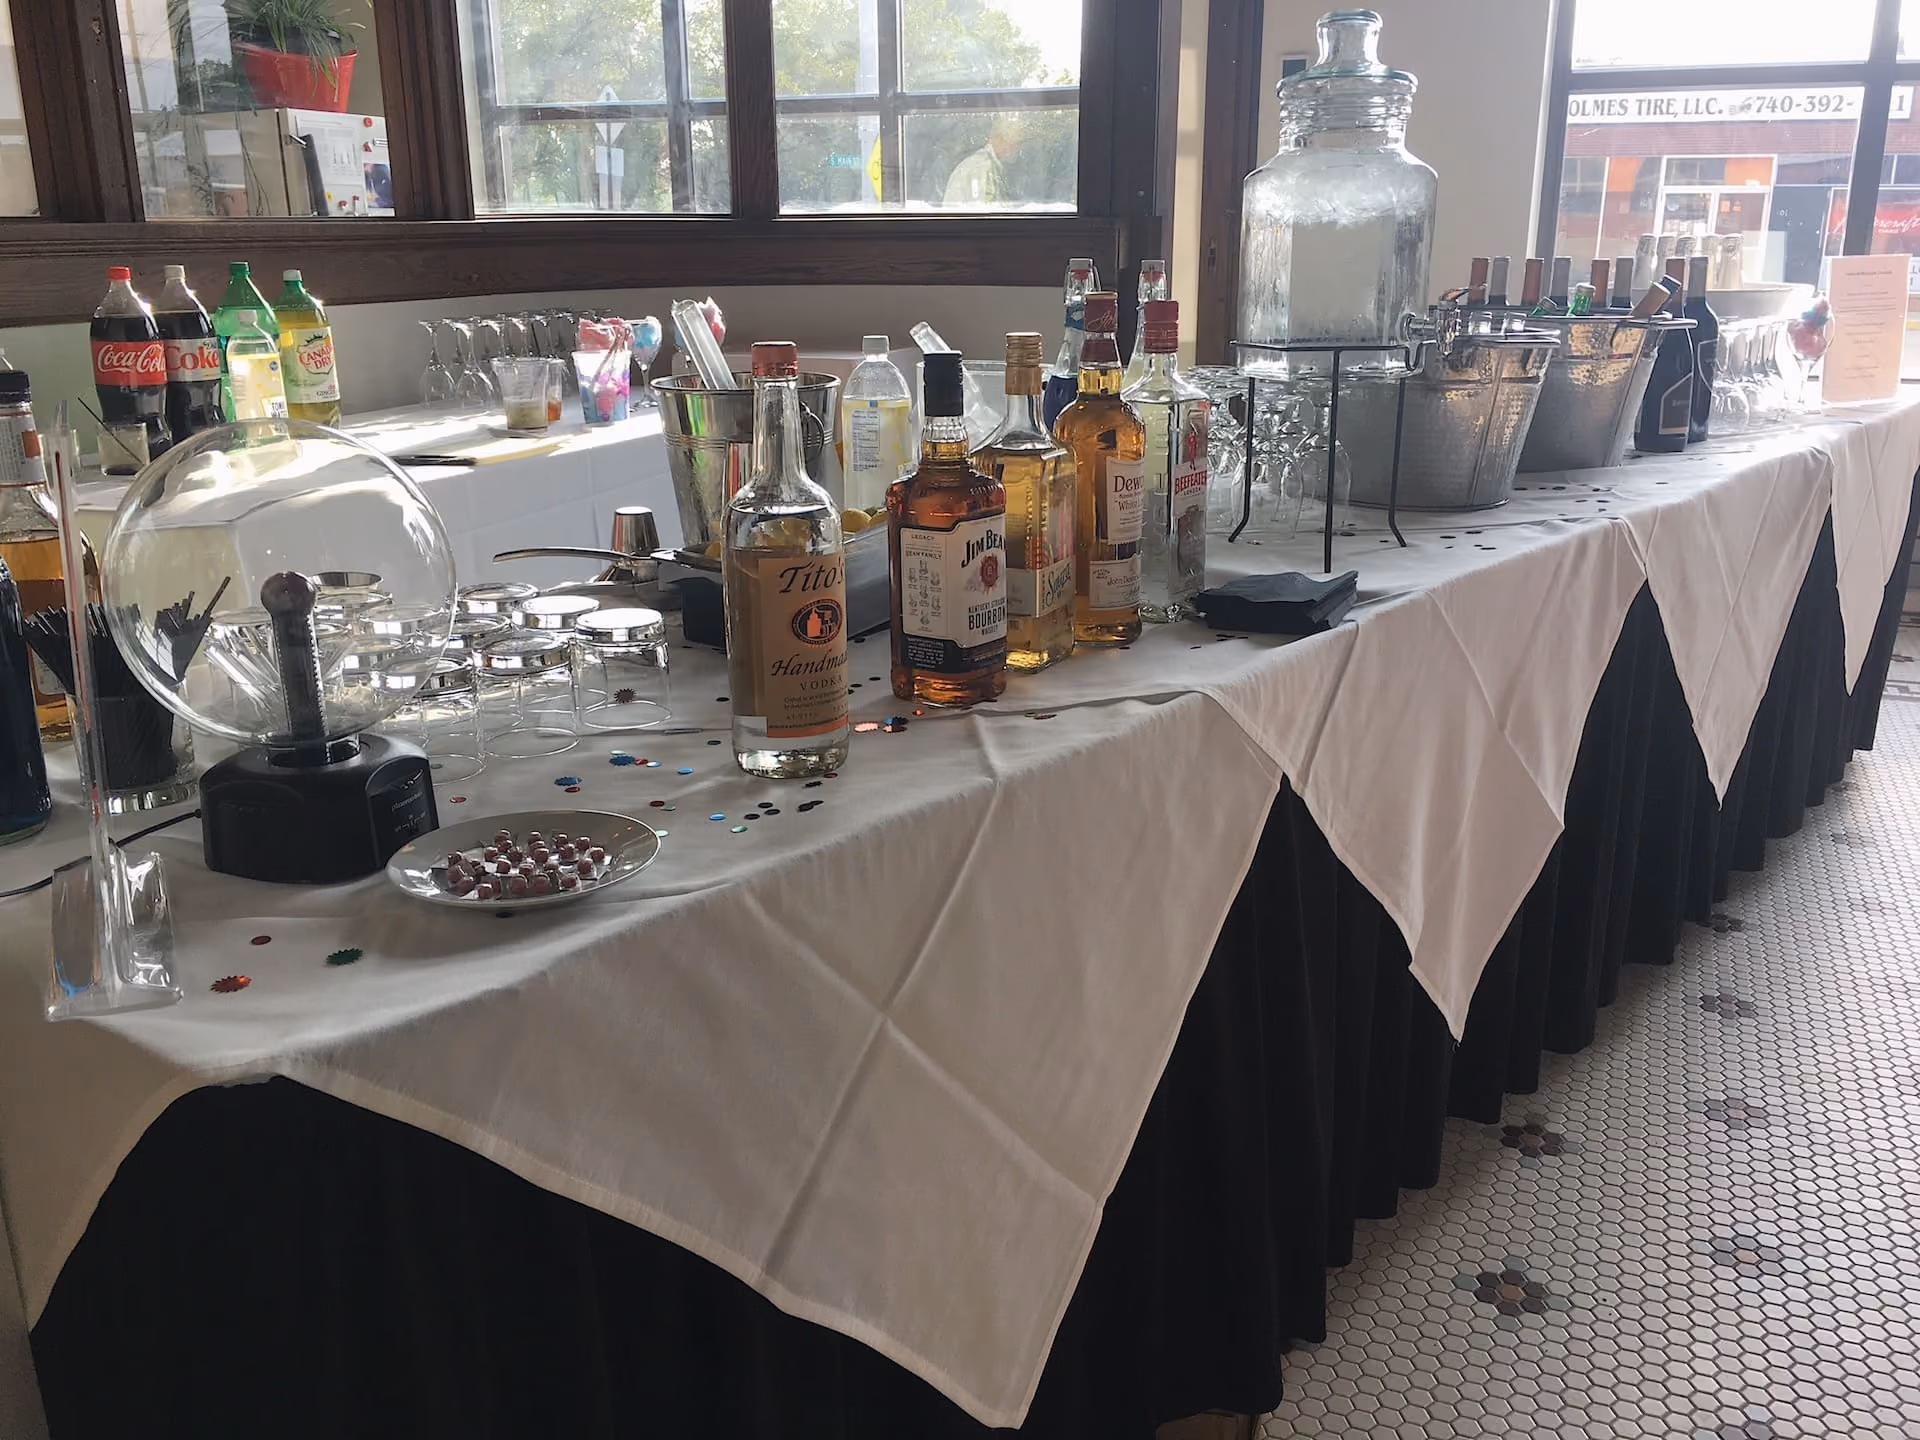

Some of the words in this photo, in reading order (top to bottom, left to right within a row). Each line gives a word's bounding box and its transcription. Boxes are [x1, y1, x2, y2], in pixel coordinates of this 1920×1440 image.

[1568, 98, 1629, 117] OLMES
[1636, 98, 1678, 118] TIRE,
[1683, 97, 1723, 115] LLC.
[97, 343, 166, 373] Coca-Cola
[299, 344, 334, 367] CANAD
[314, 356, 333, 370] DRY
[911, 533, 936, 541] LEGACY
[961, 537, 984, 569] JIM
[779, 555, 846, 594] Tito's
[771, 648, 847, 677] Handma
[800, 676, 843, 692] VODKA
